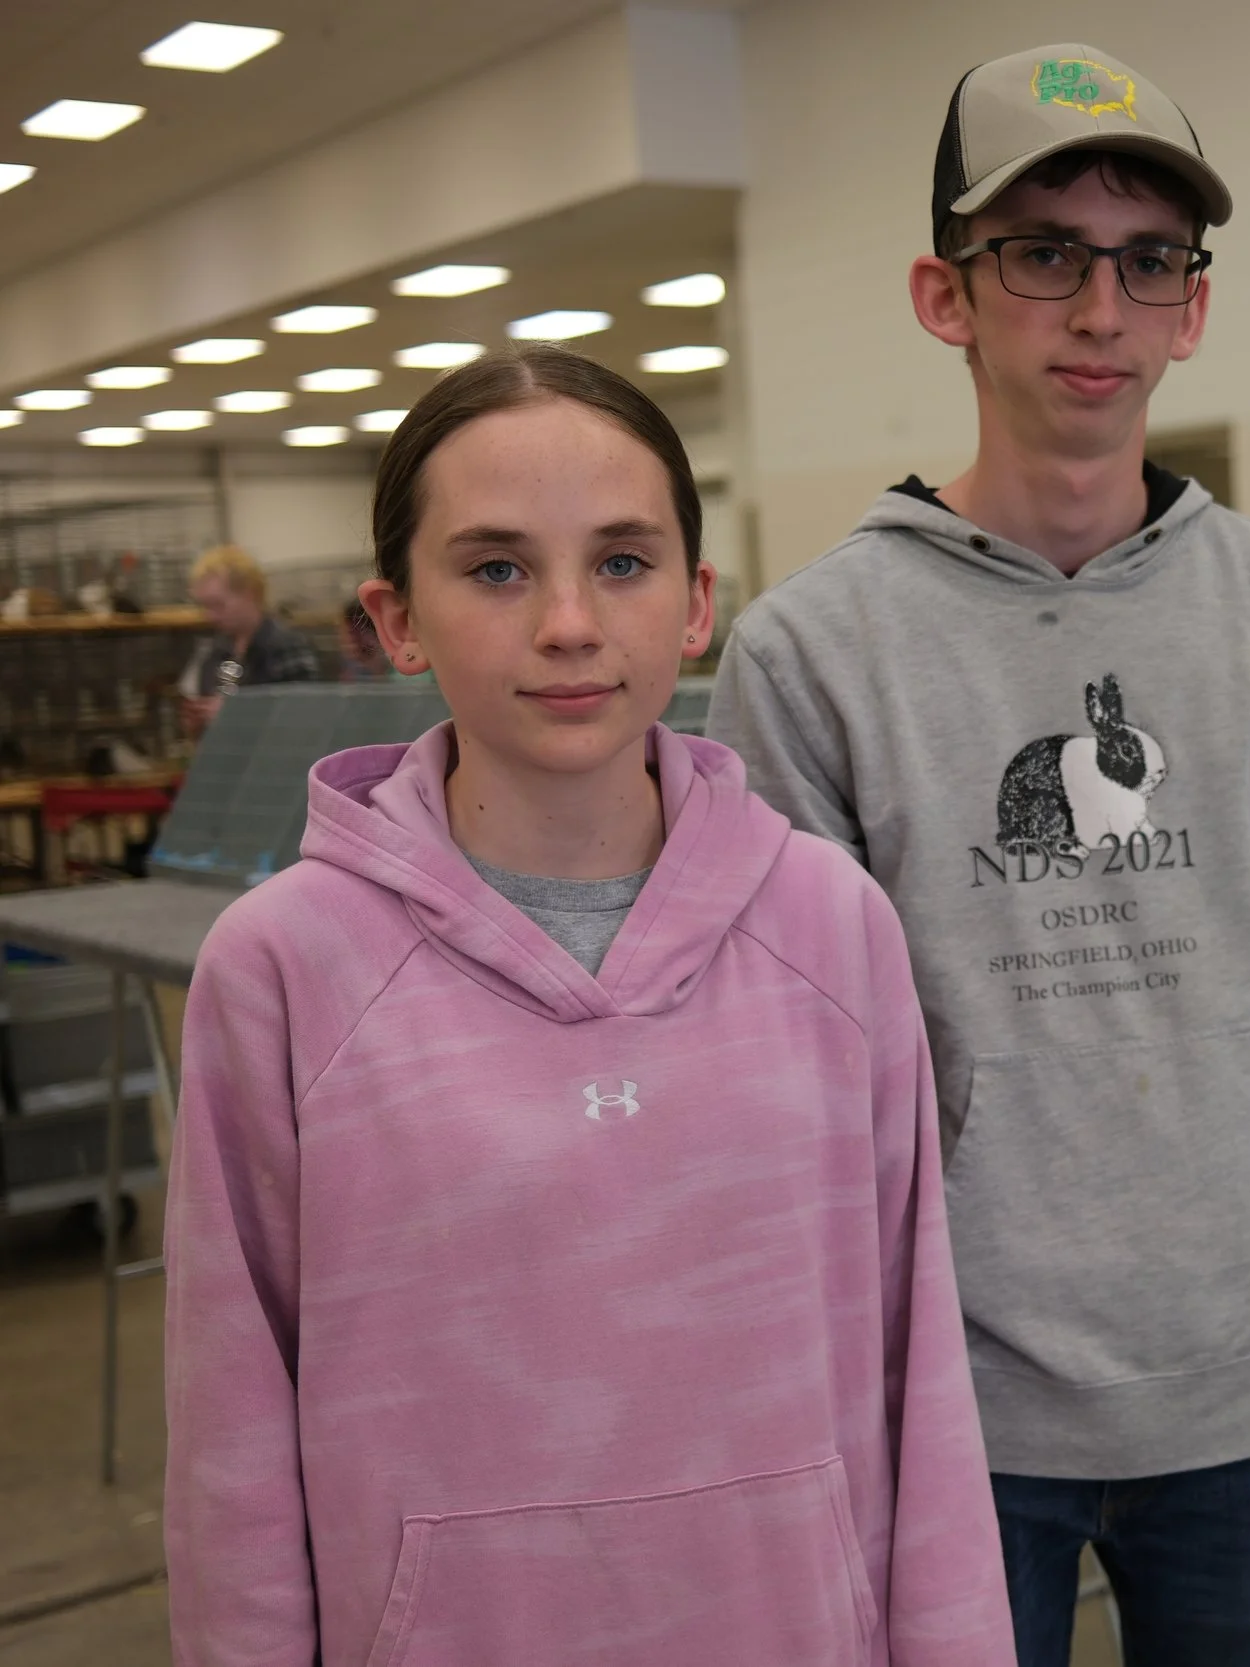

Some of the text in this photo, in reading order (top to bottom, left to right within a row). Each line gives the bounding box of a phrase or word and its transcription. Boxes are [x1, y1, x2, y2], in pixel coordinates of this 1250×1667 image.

[968, 828, 1197, 887] NDS 2021
[1041, 900, 1139, 931] OSDRC
[988, 937, 1198, 974] SPRINGFIELD, OHIO
[1013, 972, 1182, 1002] The Champion City
